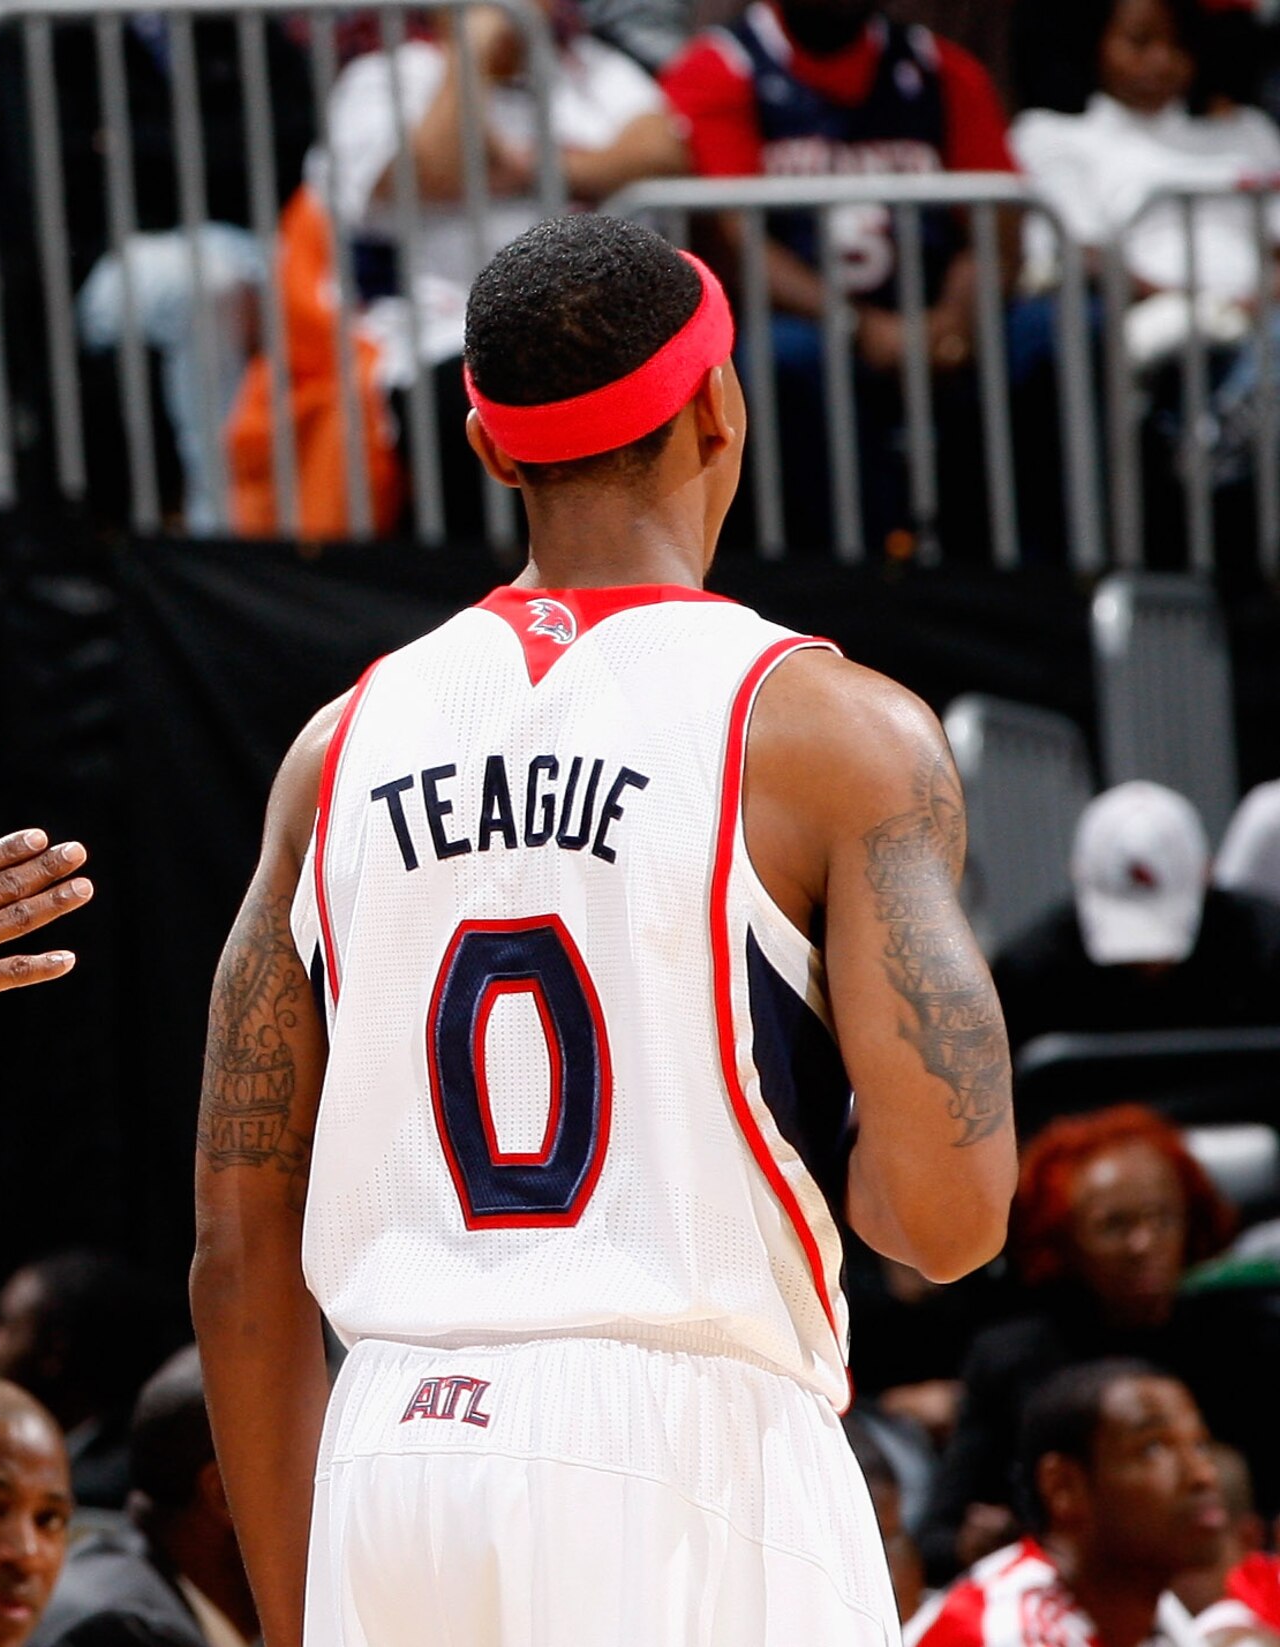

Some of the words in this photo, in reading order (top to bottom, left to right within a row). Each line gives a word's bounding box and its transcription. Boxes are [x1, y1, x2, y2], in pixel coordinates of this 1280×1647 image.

[370, 754, 650, 872] TEAGUE
[426, 914, 613, 1230] 0
[399, 1375, 491, 1429] ATL
